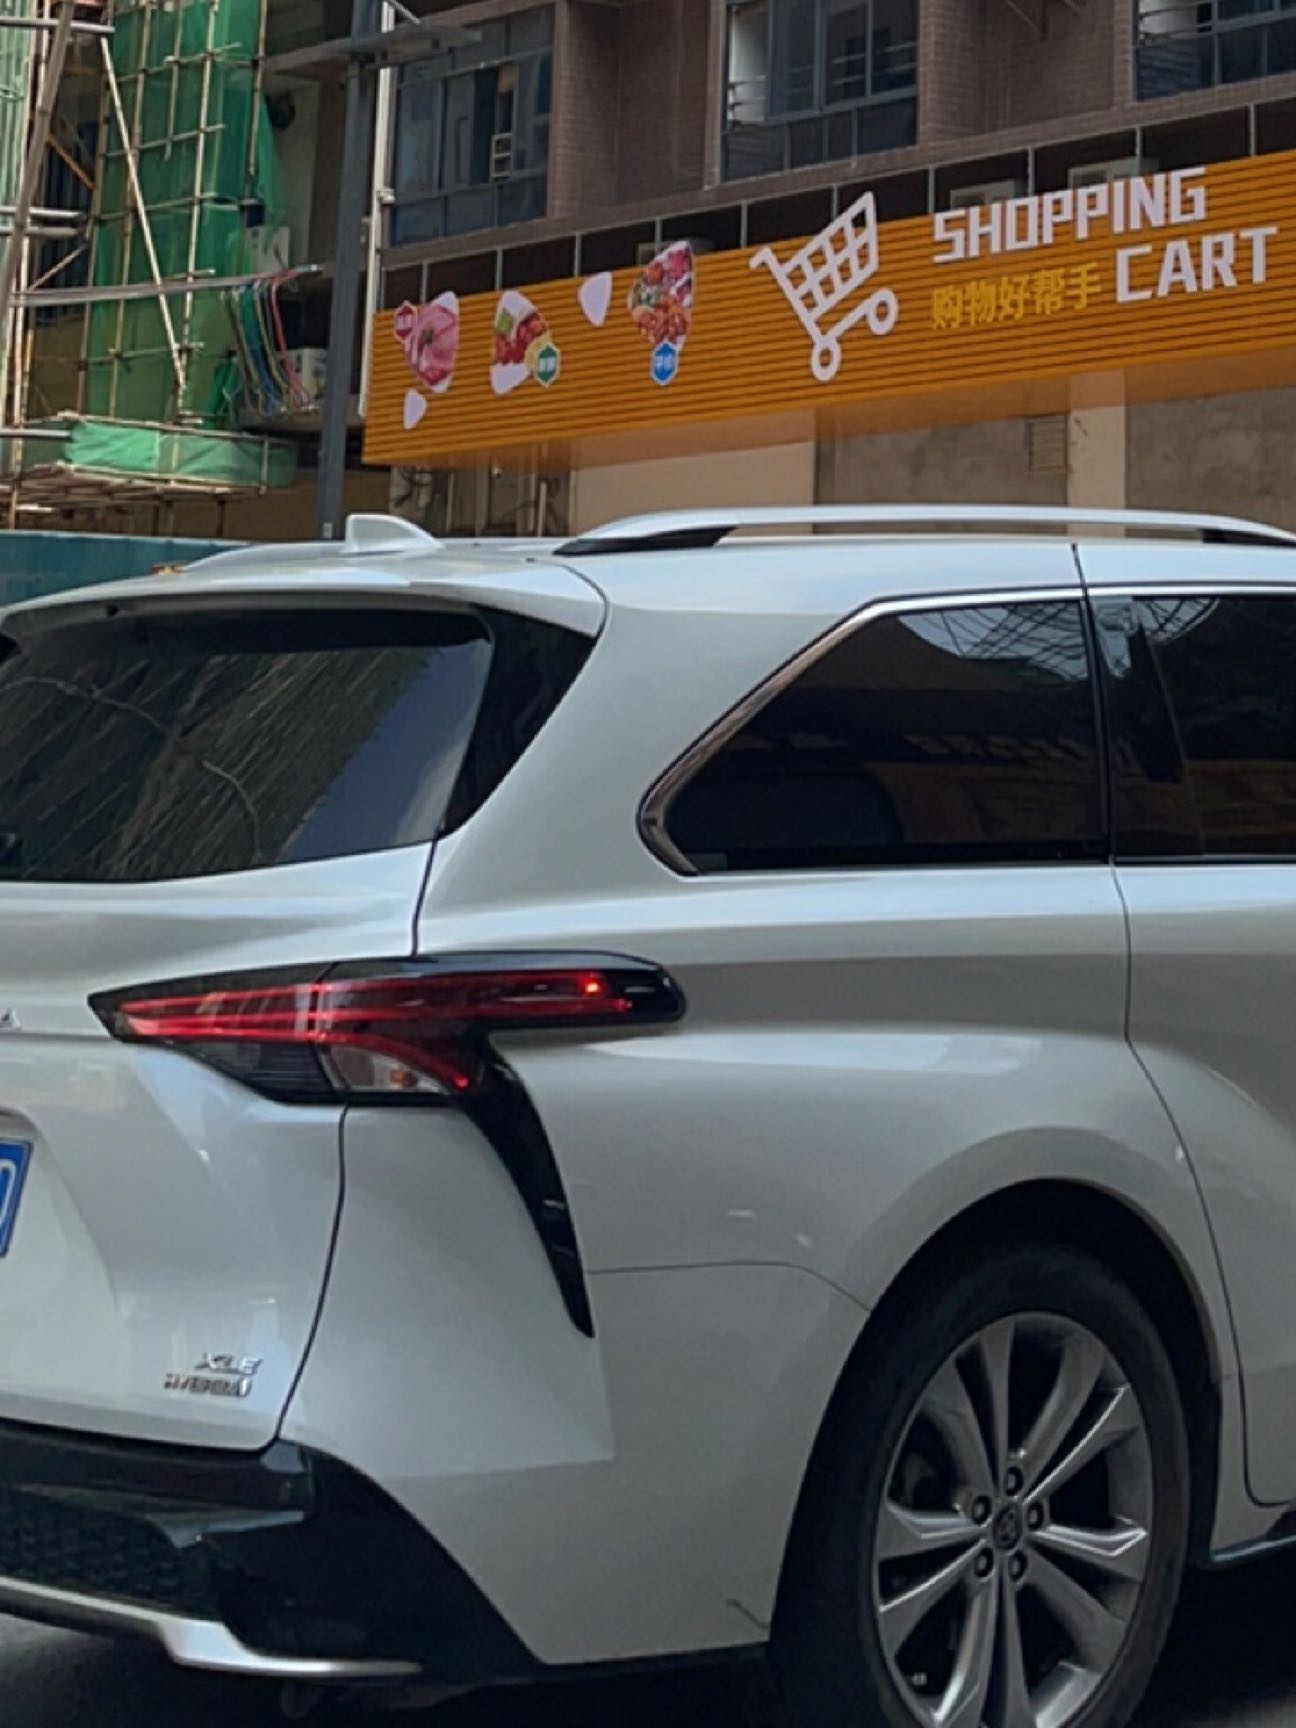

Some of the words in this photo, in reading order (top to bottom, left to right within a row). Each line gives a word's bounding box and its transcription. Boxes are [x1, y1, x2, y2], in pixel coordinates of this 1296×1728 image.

[933, 167, 1207, 264] SHOPPING
[933, 262, 1100, 329] 购物好帮手
[1116, 225, 1279, 303] CART
[195, 1352, 263, 1376] XLE
